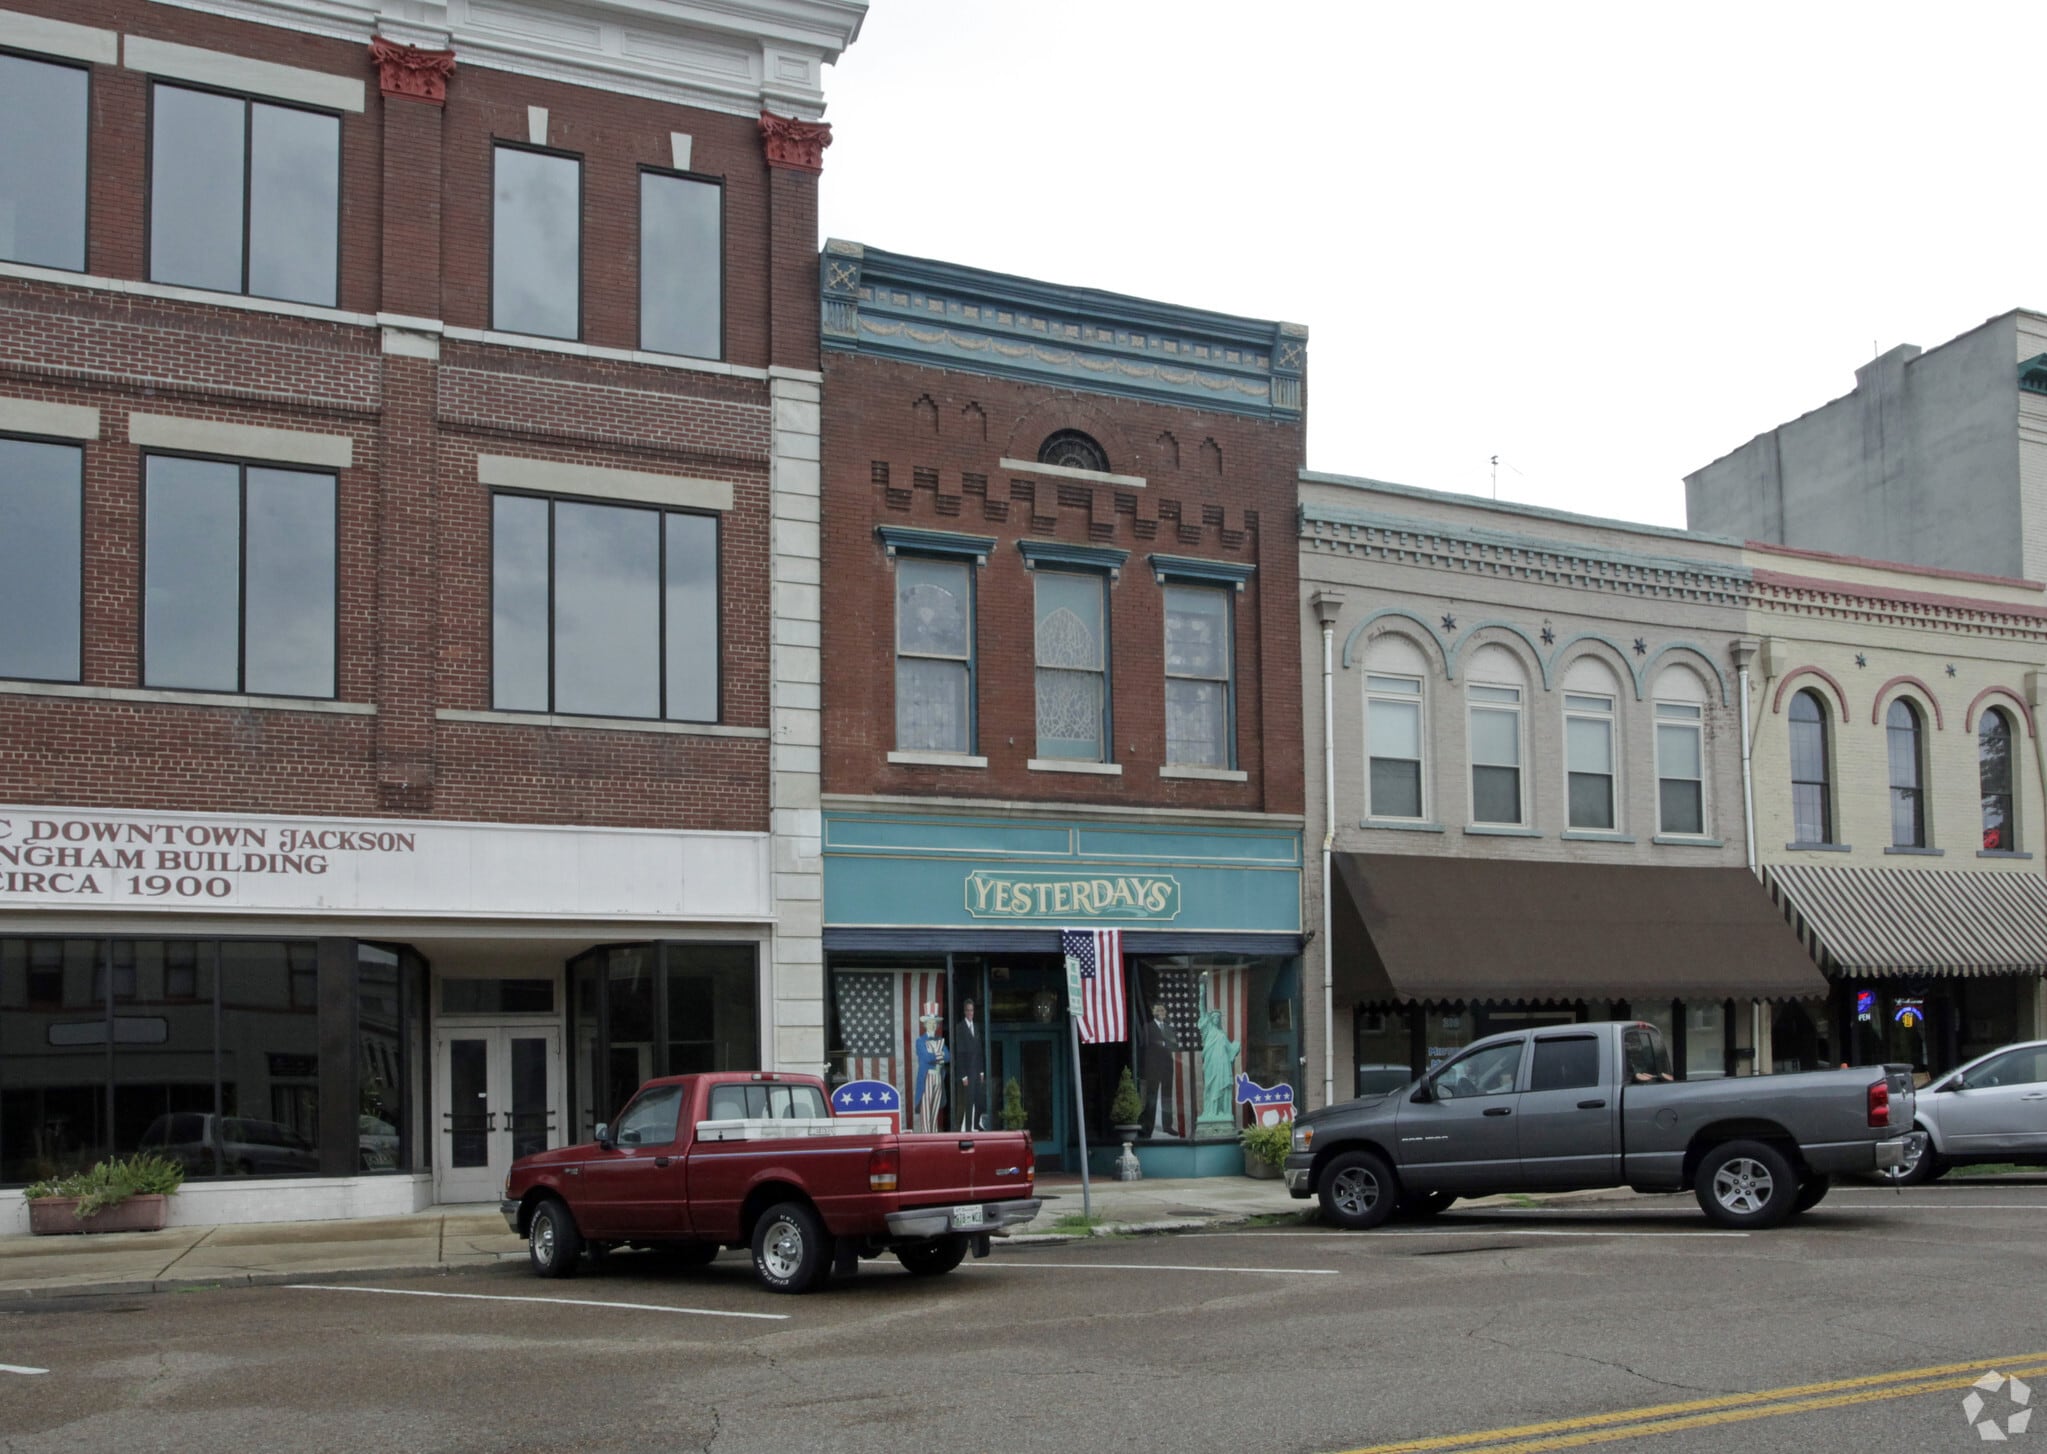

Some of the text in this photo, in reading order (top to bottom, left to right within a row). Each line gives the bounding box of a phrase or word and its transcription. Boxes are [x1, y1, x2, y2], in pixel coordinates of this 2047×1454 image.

[22, 820, 267, 845] DOWNTOWN
[279, 829, 415, 853] JACKSON
[157, 850, 329, 875] BUILDING
[0, 871, 232, 897] IRCA 1900
[973, 876, 1172, 914] YESTERDAYS
